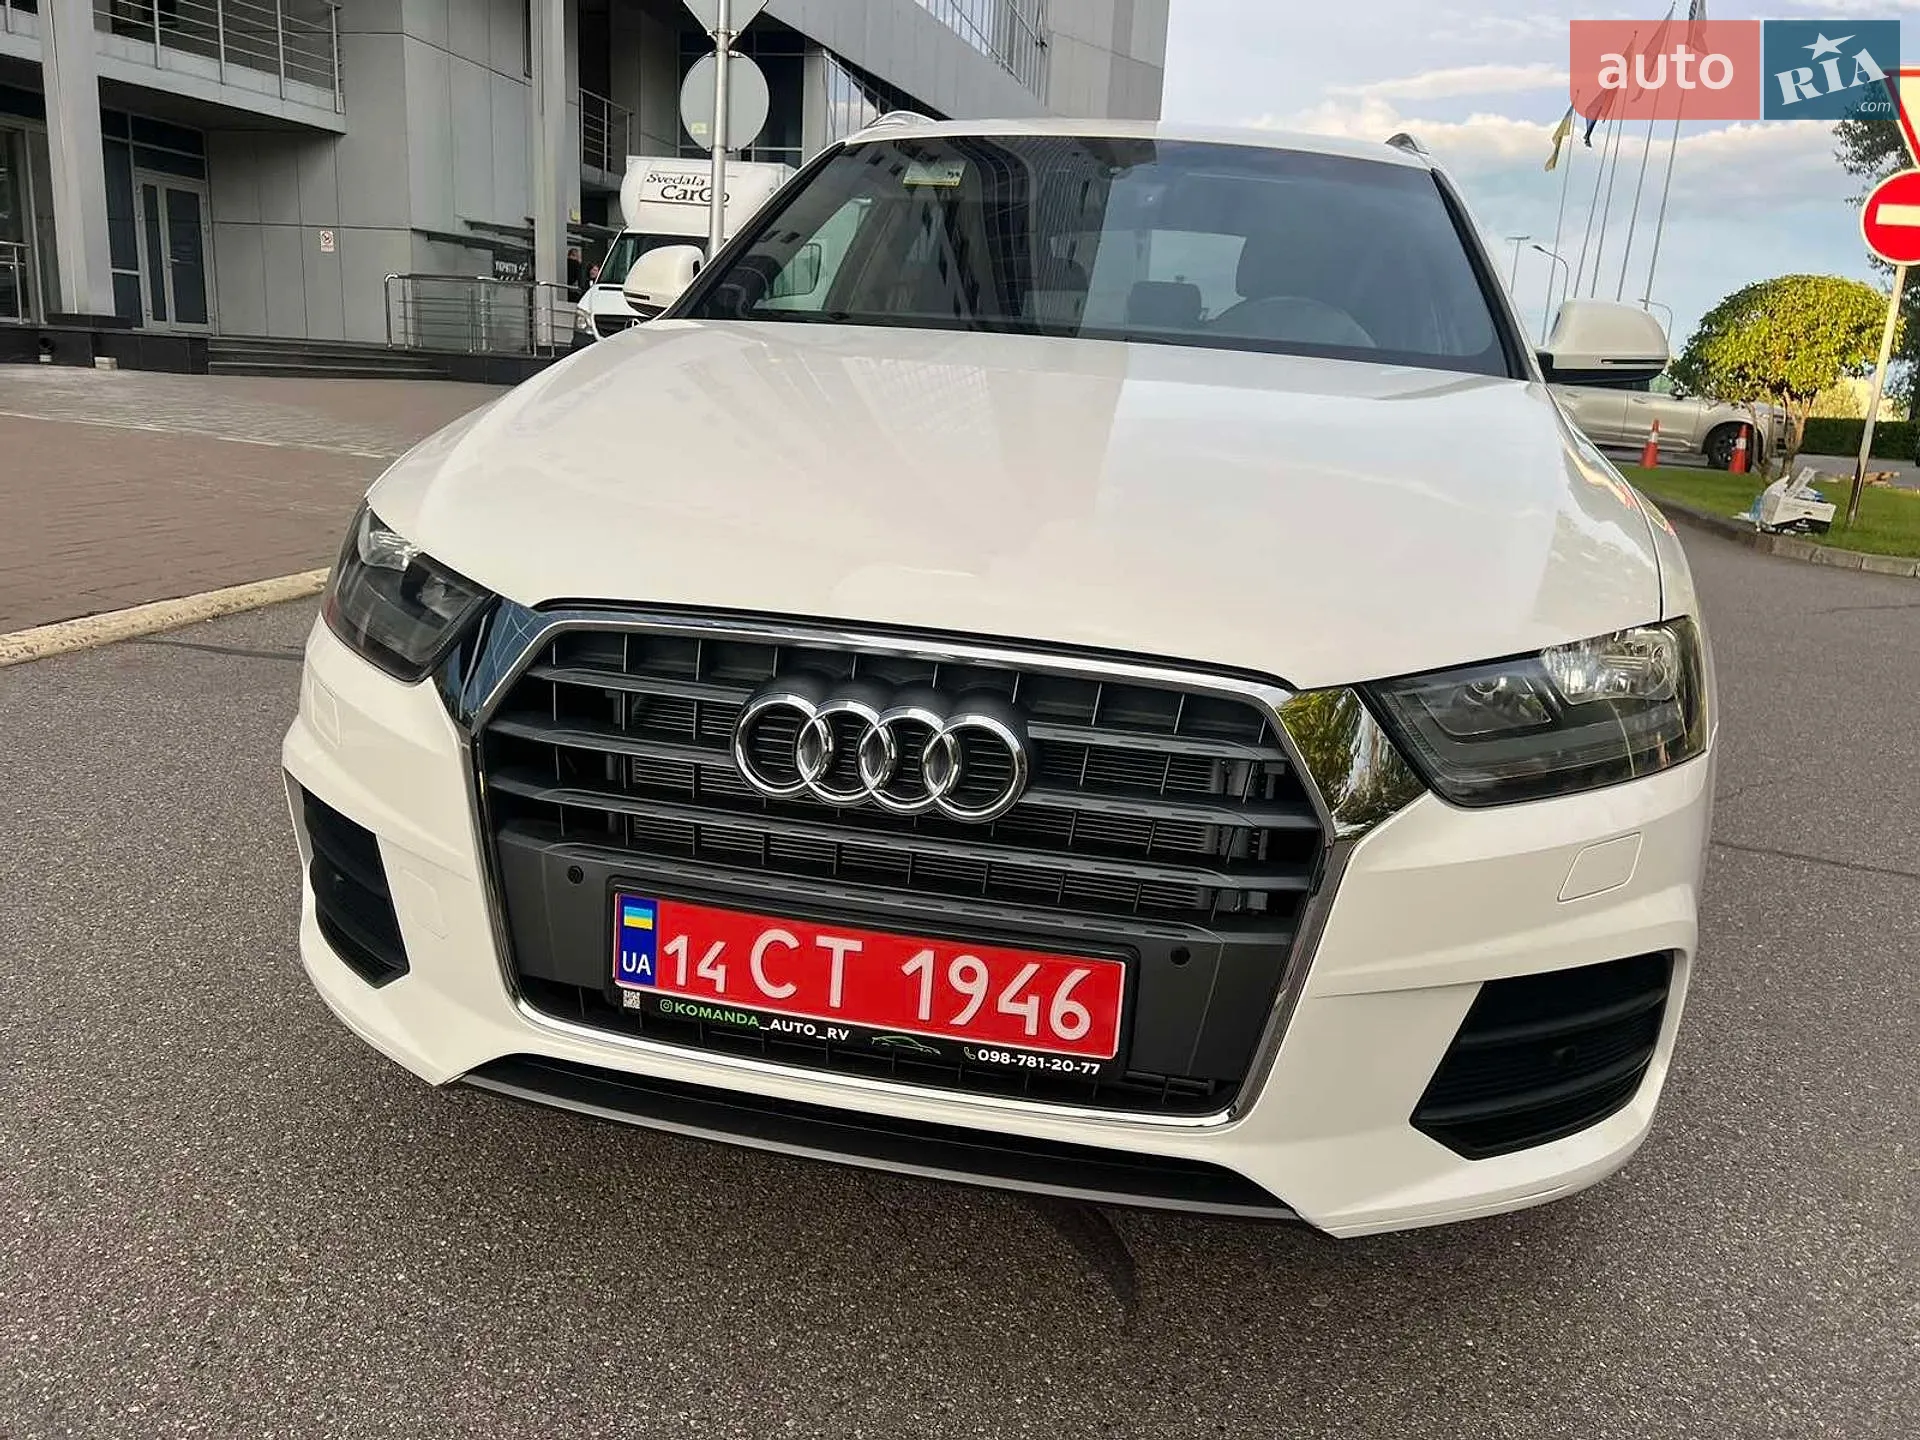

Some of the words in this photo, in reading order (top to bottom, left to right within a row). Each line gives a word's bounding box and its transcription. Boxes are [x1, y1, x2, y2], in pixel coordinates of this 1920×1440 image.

[646, 173, 706, 187] Svedala
[622, 951, 652, 976] UA
[663, 934, 728, 994] 14
[750, 928, 864, 1009] CT
[900, 950, 1092, 1042] 1946
[977, 1048, 1101, 1075] 098-781-20-77
